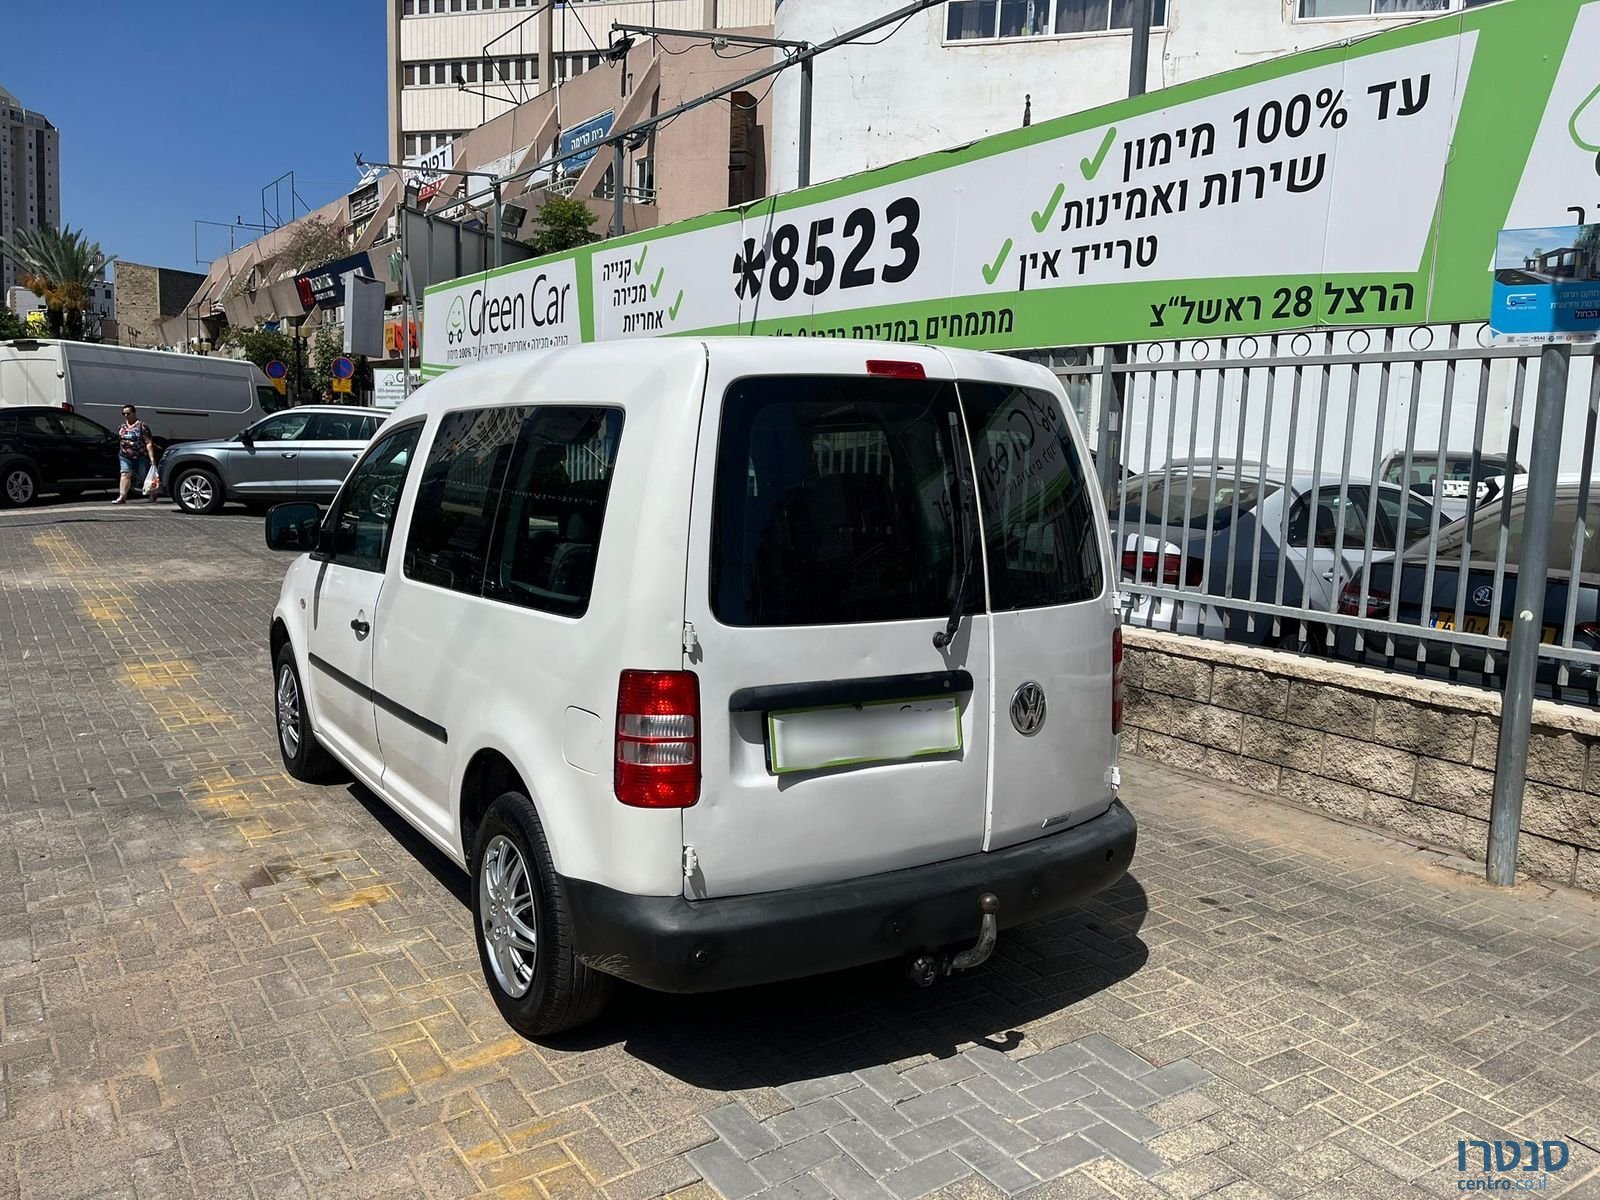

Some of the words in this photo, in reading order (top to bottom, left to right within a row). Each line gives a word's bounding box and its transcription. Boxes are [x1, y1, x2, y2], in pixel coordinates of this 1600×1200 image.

[1367, 74, 1430, 120] עד
[592, 127, 604, 141] בית
[1233, 88, 1348, 149] 100%
[420, 150, 446, 177] דפוס
[1123, 123, 1215, 183] מימון
[1199, 153, 1326, 209] שירות
[1061, 179, 1188, 232] ואמינות
[602, 259, 632, 283] קנייה
[1019, 249, 1061, 291] אין
[1072, 235, 1158, 275] טרייד
[468, 289, 525, 337] Green
[531, 274, 571, 327] Car
[613, 283, 647, 307] מכירה
[1272, 286, 1313, 319] 28
[1324, 282, 1414, 315] הרצל
[623, 310, 664, 333] אחריות
[926, 308, 1013, 340] מתמחים
[459, 347, 472, 359] 100%
[490, 342, 504, 355] טרייד
[507, 340, 527, 353] אחריות
[531, 337, 549, 350] מכירה
